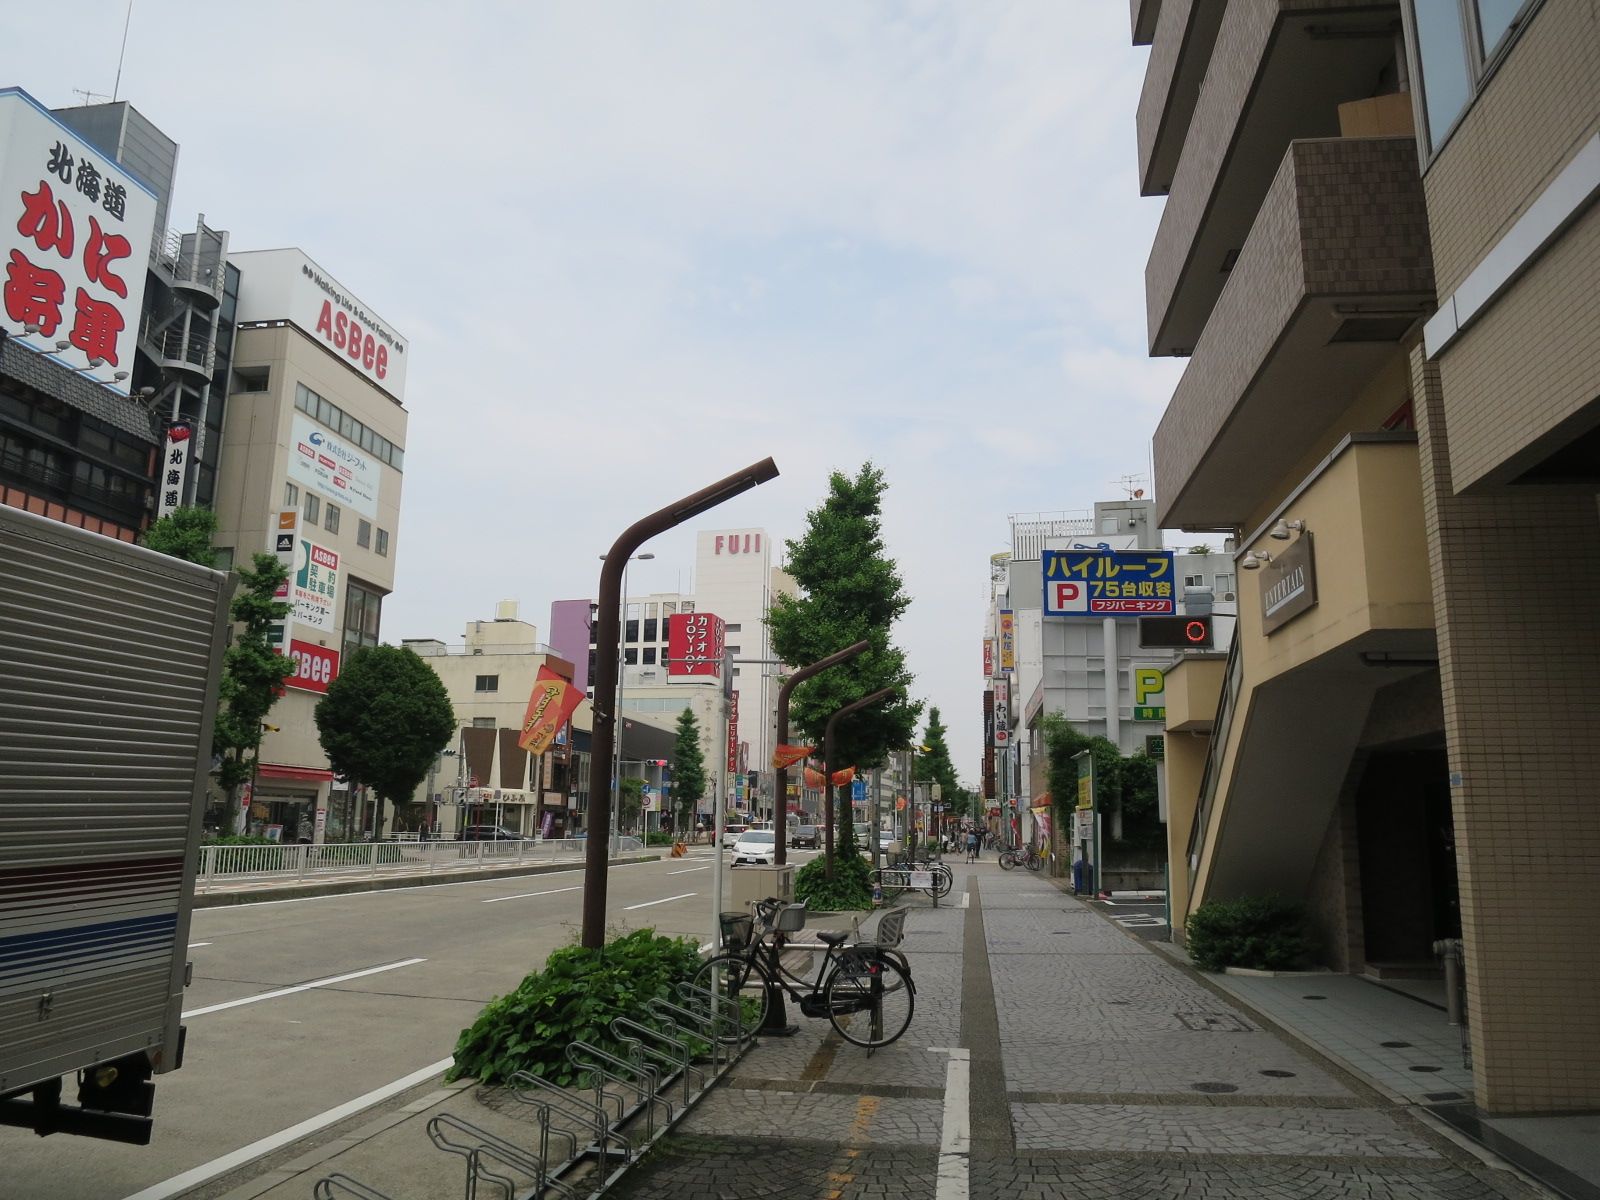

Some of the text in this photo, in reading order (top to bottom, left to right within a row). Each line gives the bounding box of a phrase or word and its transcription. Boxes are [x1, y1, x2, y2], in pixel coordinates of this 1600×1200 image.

[47, 140, 127, 222] 北海道
[16, 179, 133, 299] かに
[316, 299, 388, 380] ASBee
[165, 449, 184, 518] 北海道
[315, 549, 336, 566] ASBee
[715, 533, 761, 555] FUJI
[1047, 556, 1169, 579] ハイルーフ
[309, 577, 335, 599] 駐車場
[1057, 584, 1079, 609] P
[1090, 581, 1171, 598] 75台収容
[1265, 564, 1305, 610] ENTERTAIN
[1096, 601, 1166, 611] フジパーキング
[685, 616, 697, 673] JOYJOY
[697, 615, 708, 665] カラオケ
[1135, 668, 1164, 705] P
